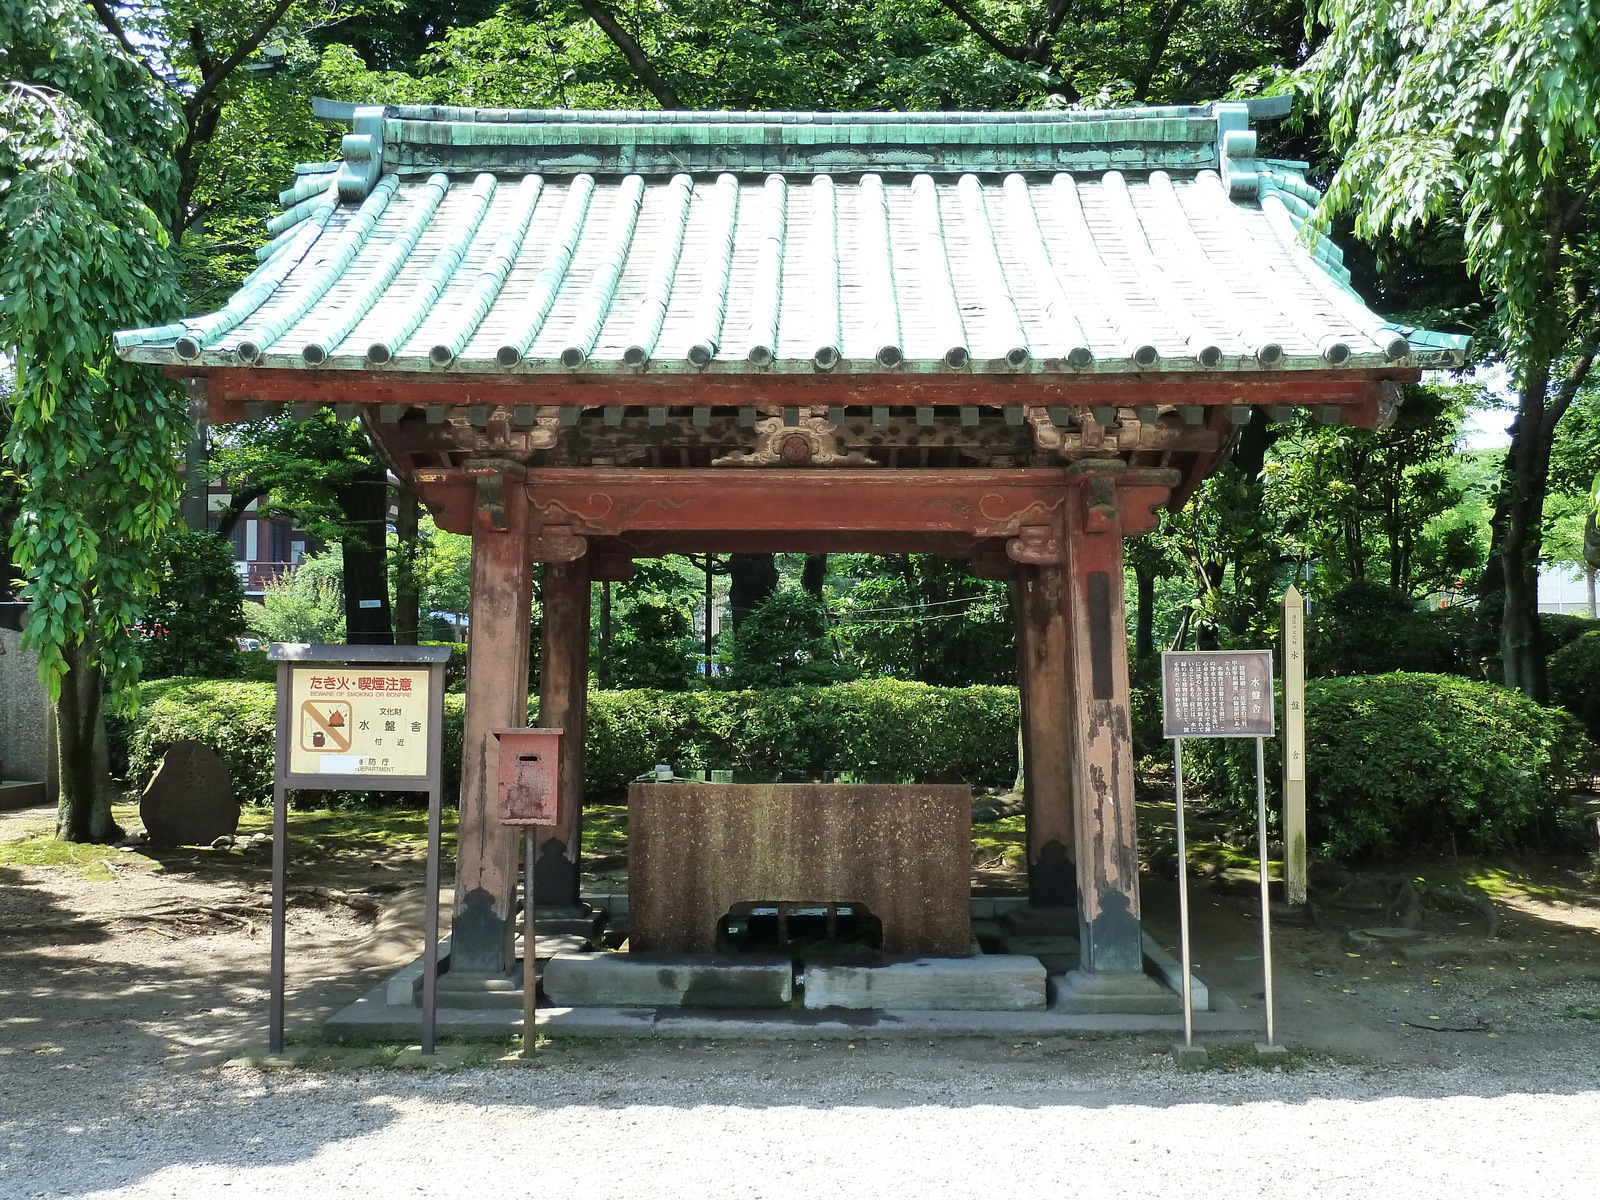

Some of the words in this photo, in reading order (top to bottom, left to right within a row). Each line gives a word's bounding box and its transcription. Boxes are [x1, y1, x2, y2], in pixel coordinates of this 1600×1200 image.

[310, 677, 412, 691] たき火・喫煙注意
[379, 707, 402, 716] 文化財
[374, 738, 405, 747] 付近
